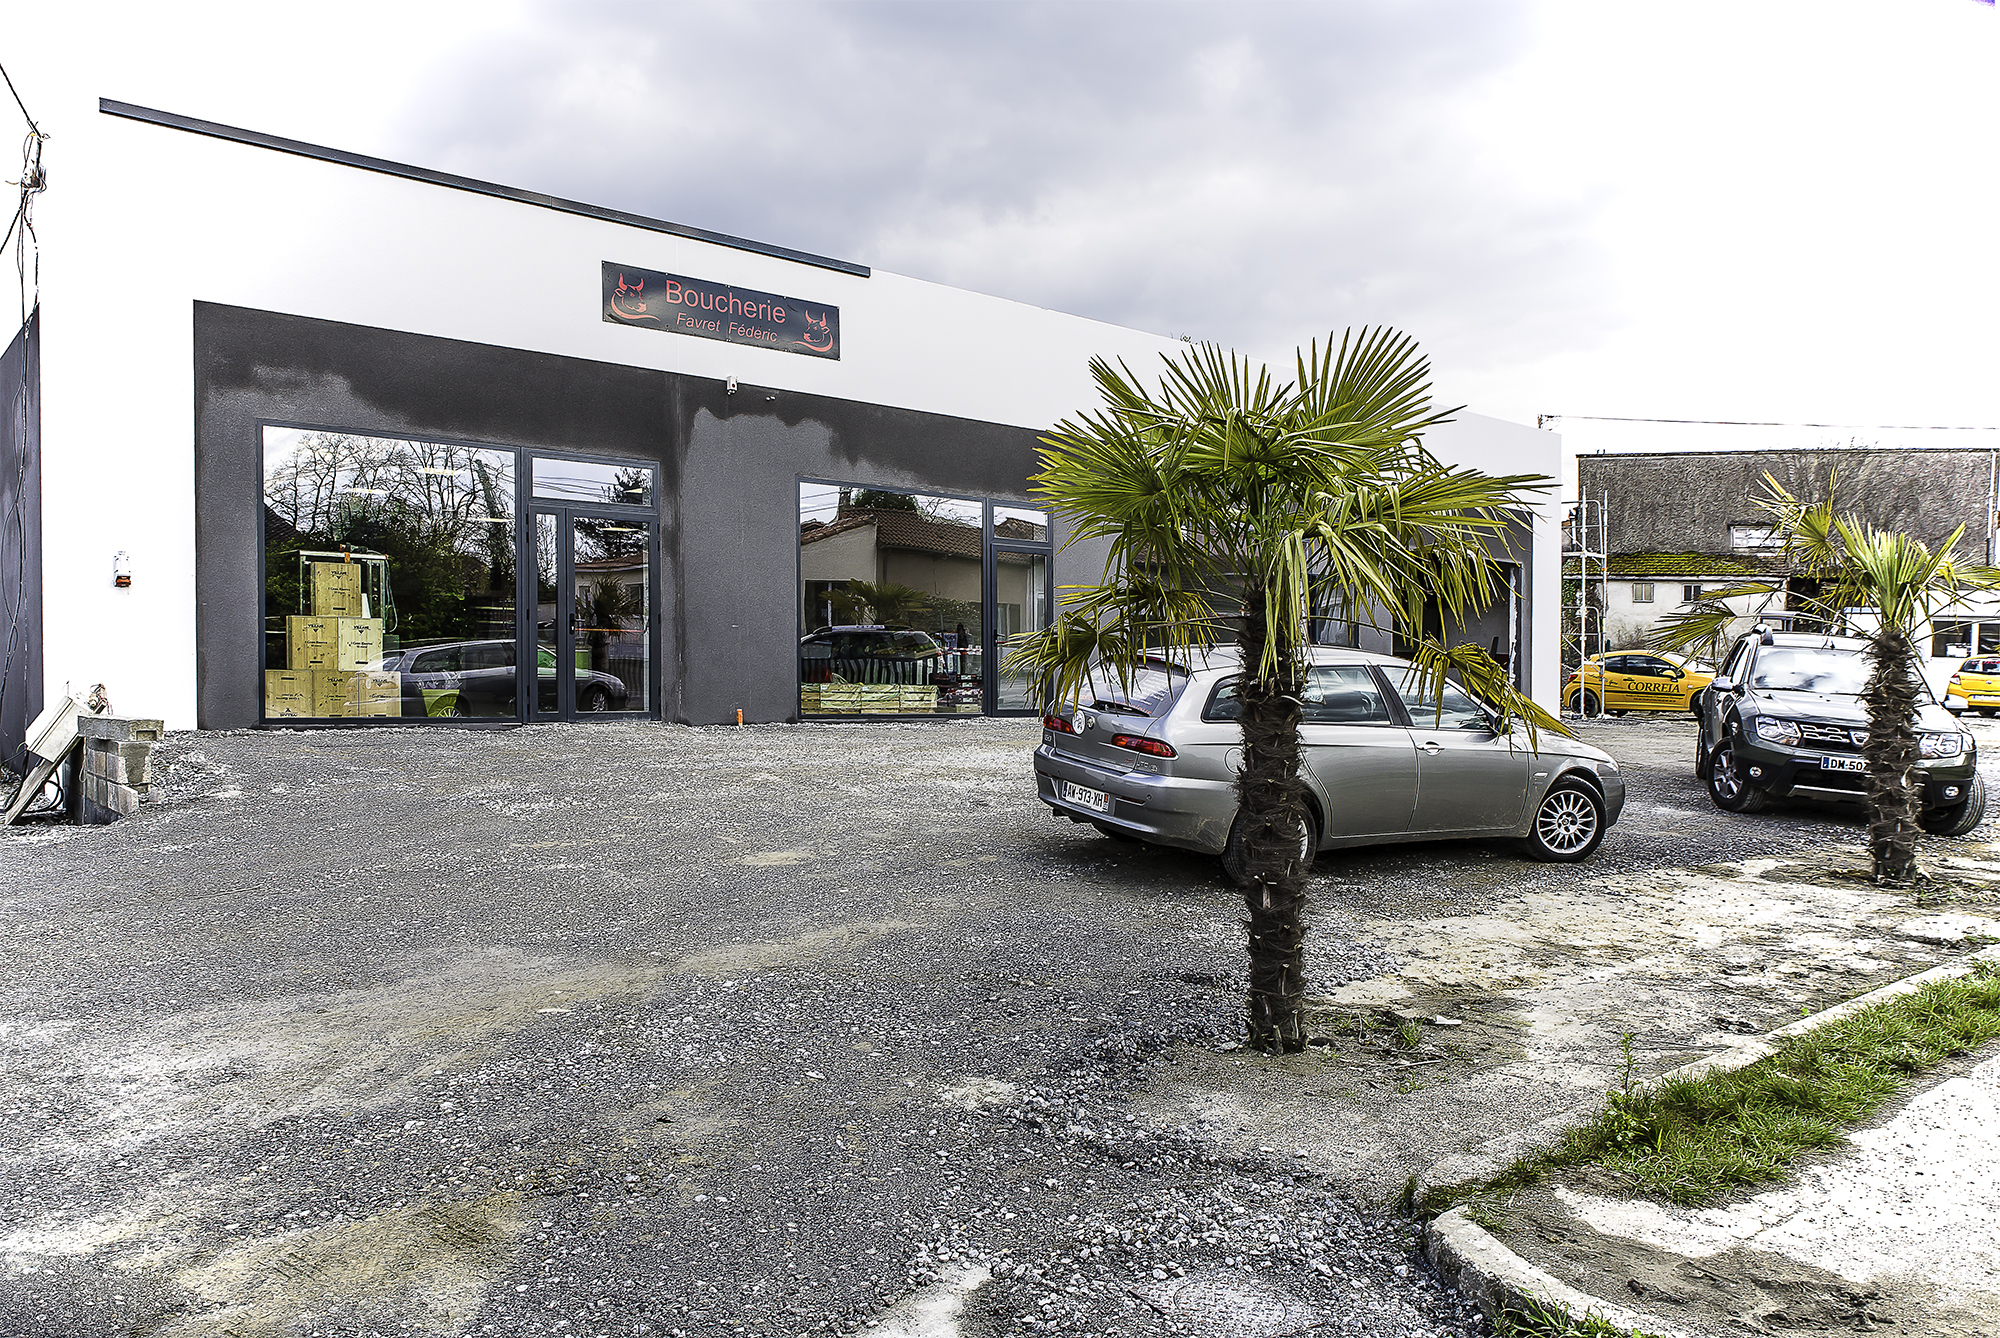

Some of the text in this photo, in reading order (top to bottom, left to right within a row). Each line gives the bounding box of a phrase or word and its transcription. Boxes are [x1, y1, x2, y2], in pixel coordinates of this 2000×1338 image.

[665, 279, 786, 324] Boucherie
[676, 312, 778, 342] Favret Fédéric
[1627, 681, 1680, 693] CORREIA
